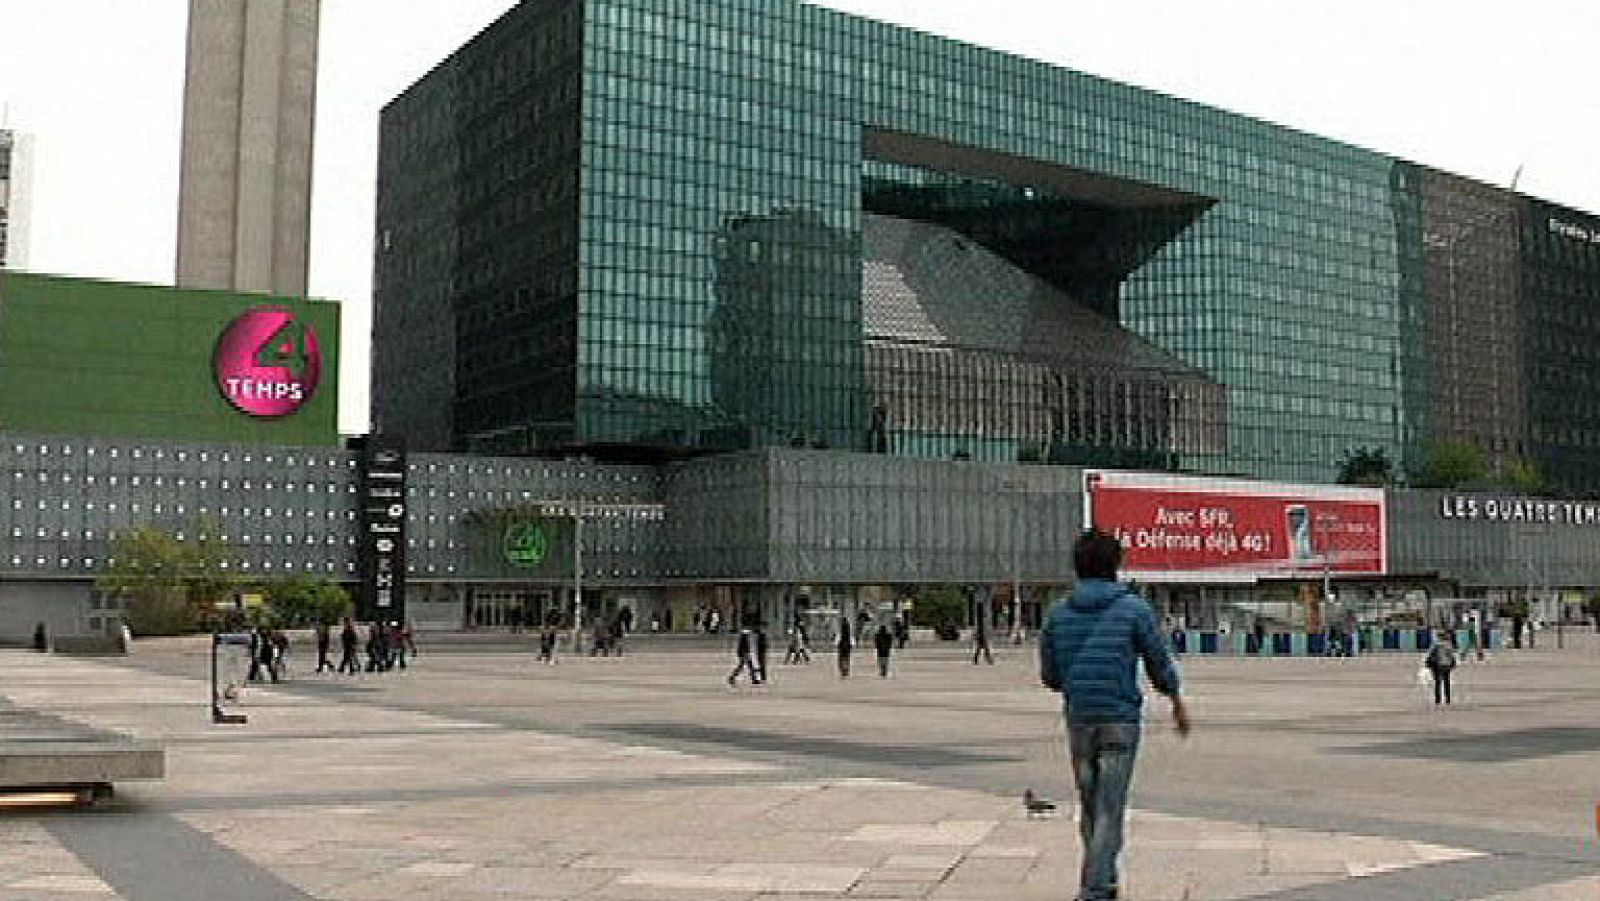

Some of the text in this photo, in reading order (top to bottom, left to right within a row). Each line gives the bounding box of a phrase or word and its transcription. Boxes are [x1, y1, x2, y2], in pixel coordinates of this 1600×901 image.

[252, 313, 307, 373] 4
[226, 378, 303, 399] TEMPS
[1155, 508, 1195, 524] Avec
[1443, 496, 1478, 516] LES
[1486, 500, 1555, 521] QUATRE
[1136, 526, 1201, 548] Défense
[1205, 529, 1239, 555] déjà
